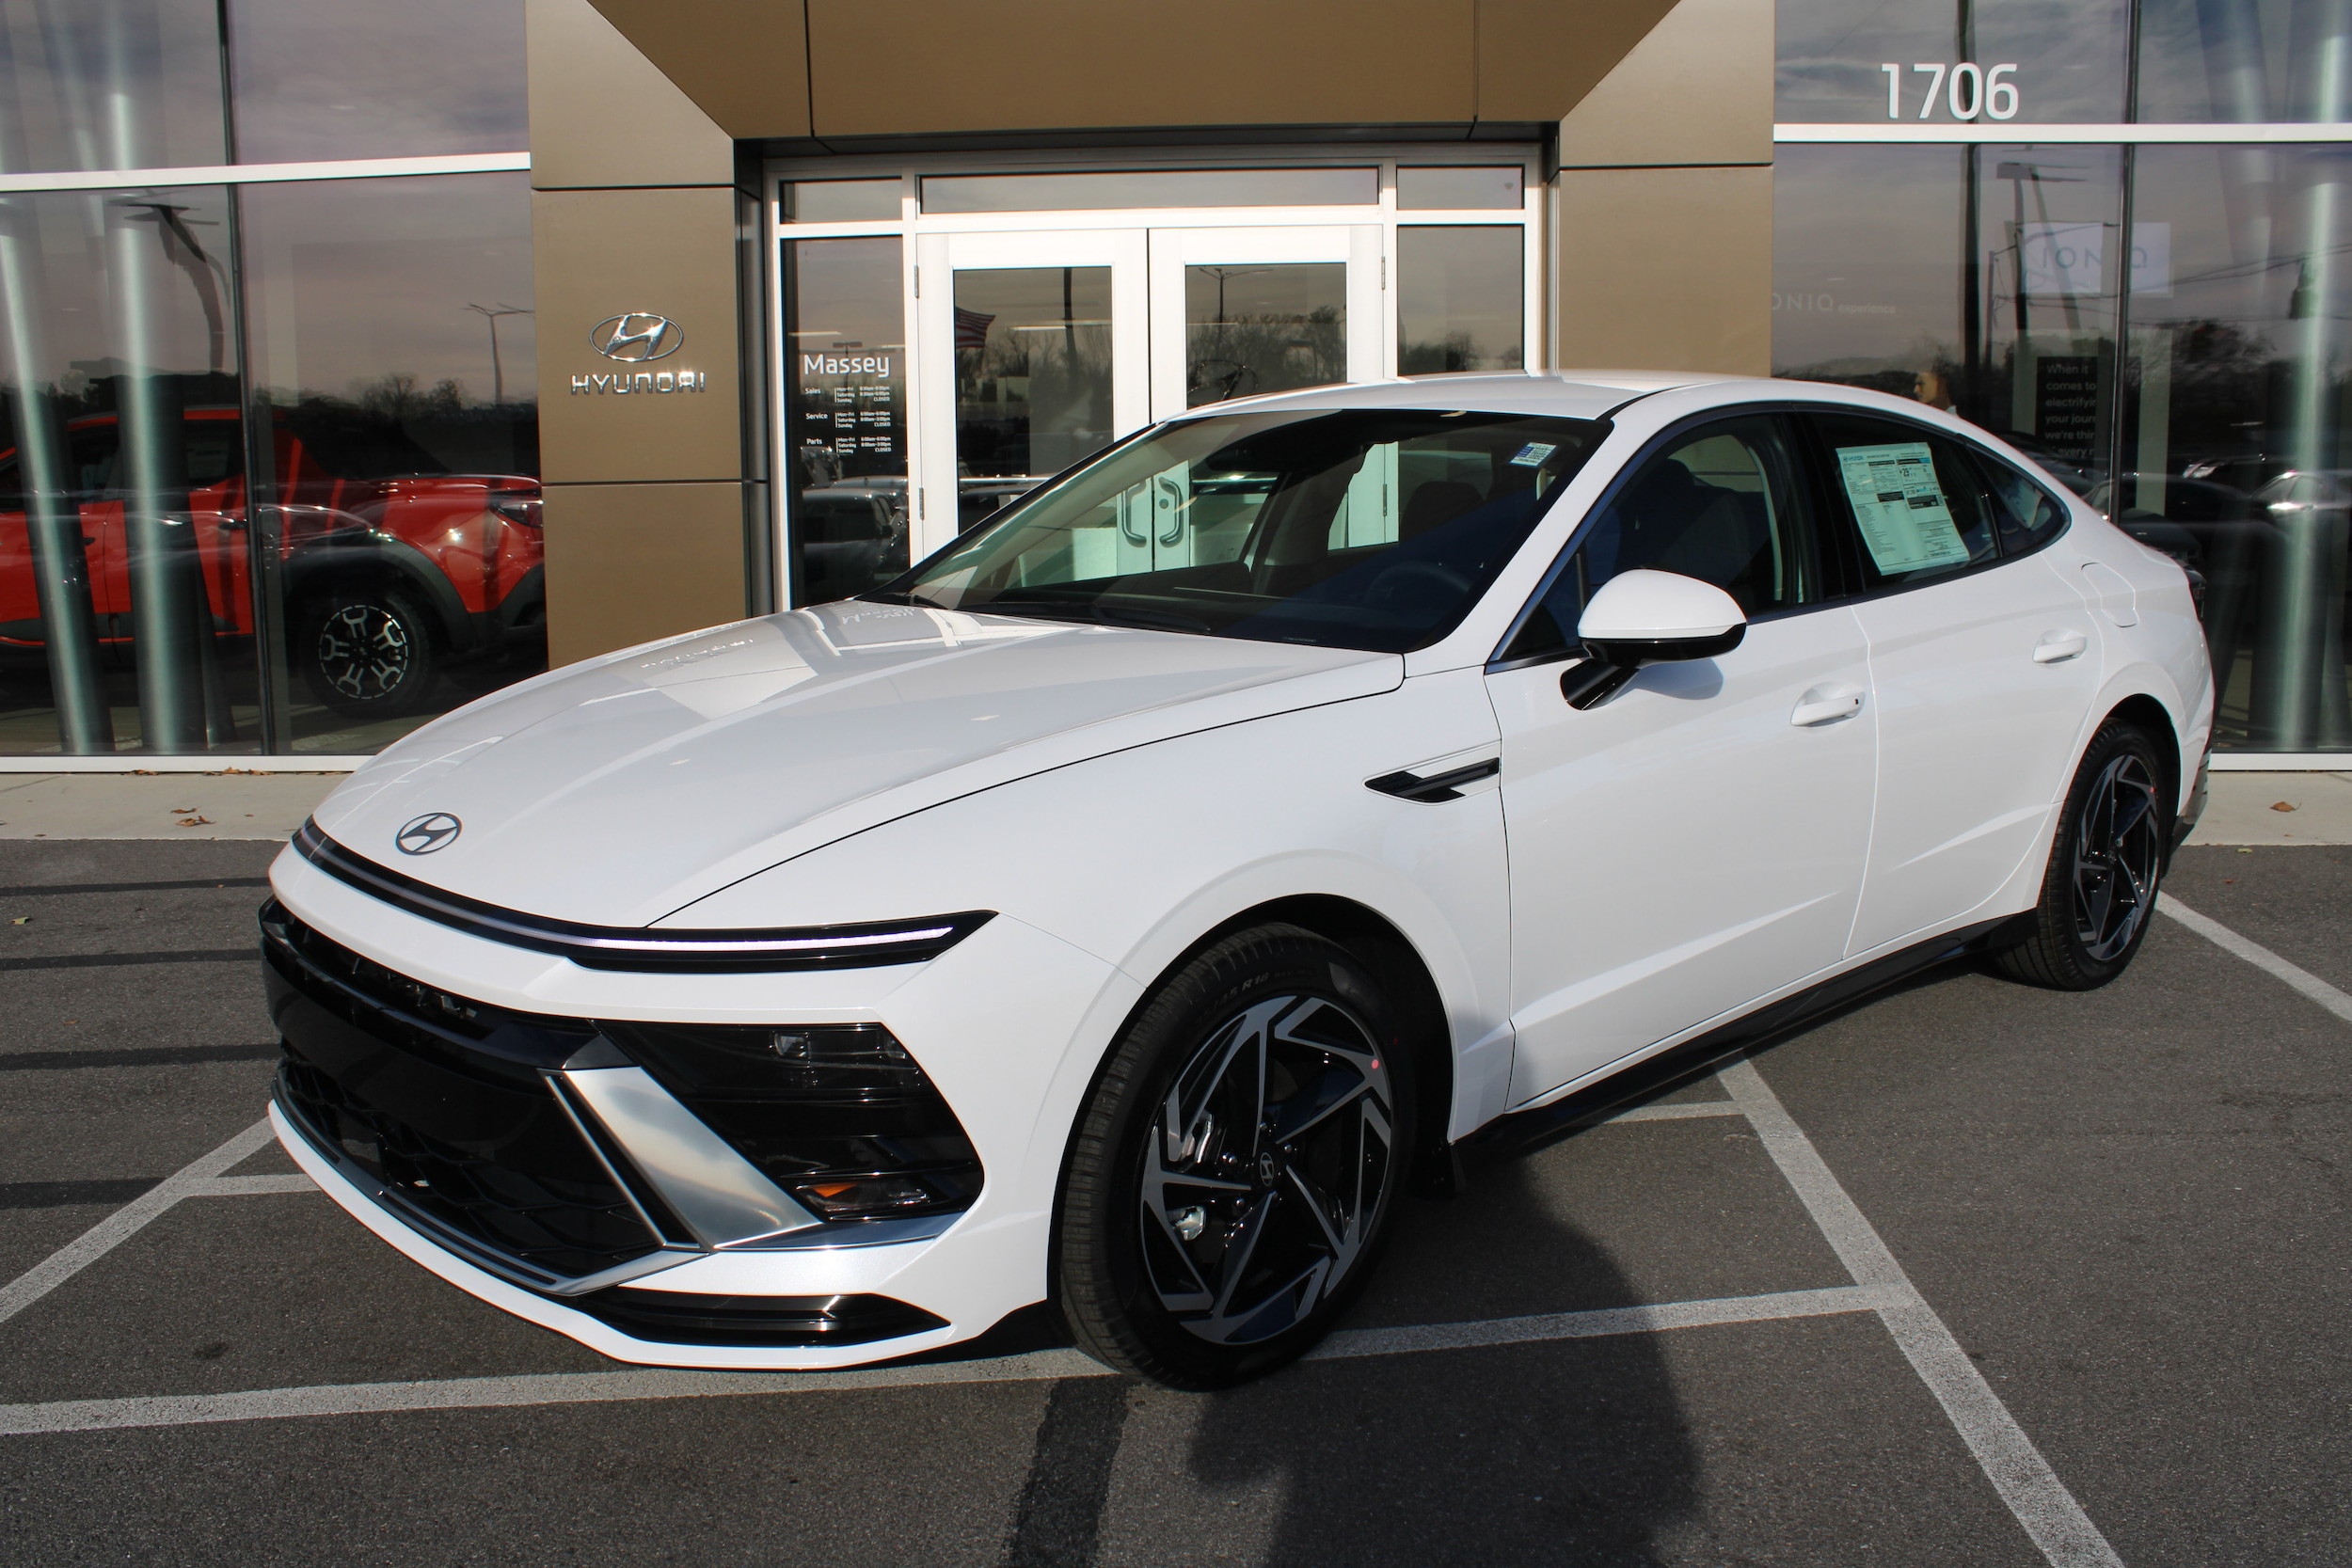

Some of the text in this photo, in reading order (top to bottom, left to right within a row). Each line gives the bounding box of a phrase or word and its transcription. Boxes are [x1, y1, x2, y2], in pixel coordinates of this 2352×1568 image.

[1881, 62, 2019, 119] 1706
[2042, 245, 2148, 269] IONQ
[804, 354, 890, 378] Massey
[2046, 364, 2089, 374] When it
[570, 372, 706, 395] HYUNDAI
[2045, 382, 2096, 391] comes to
[2045, 416, 2069, 425] your
[2044, 430, 2074, 440] we're
